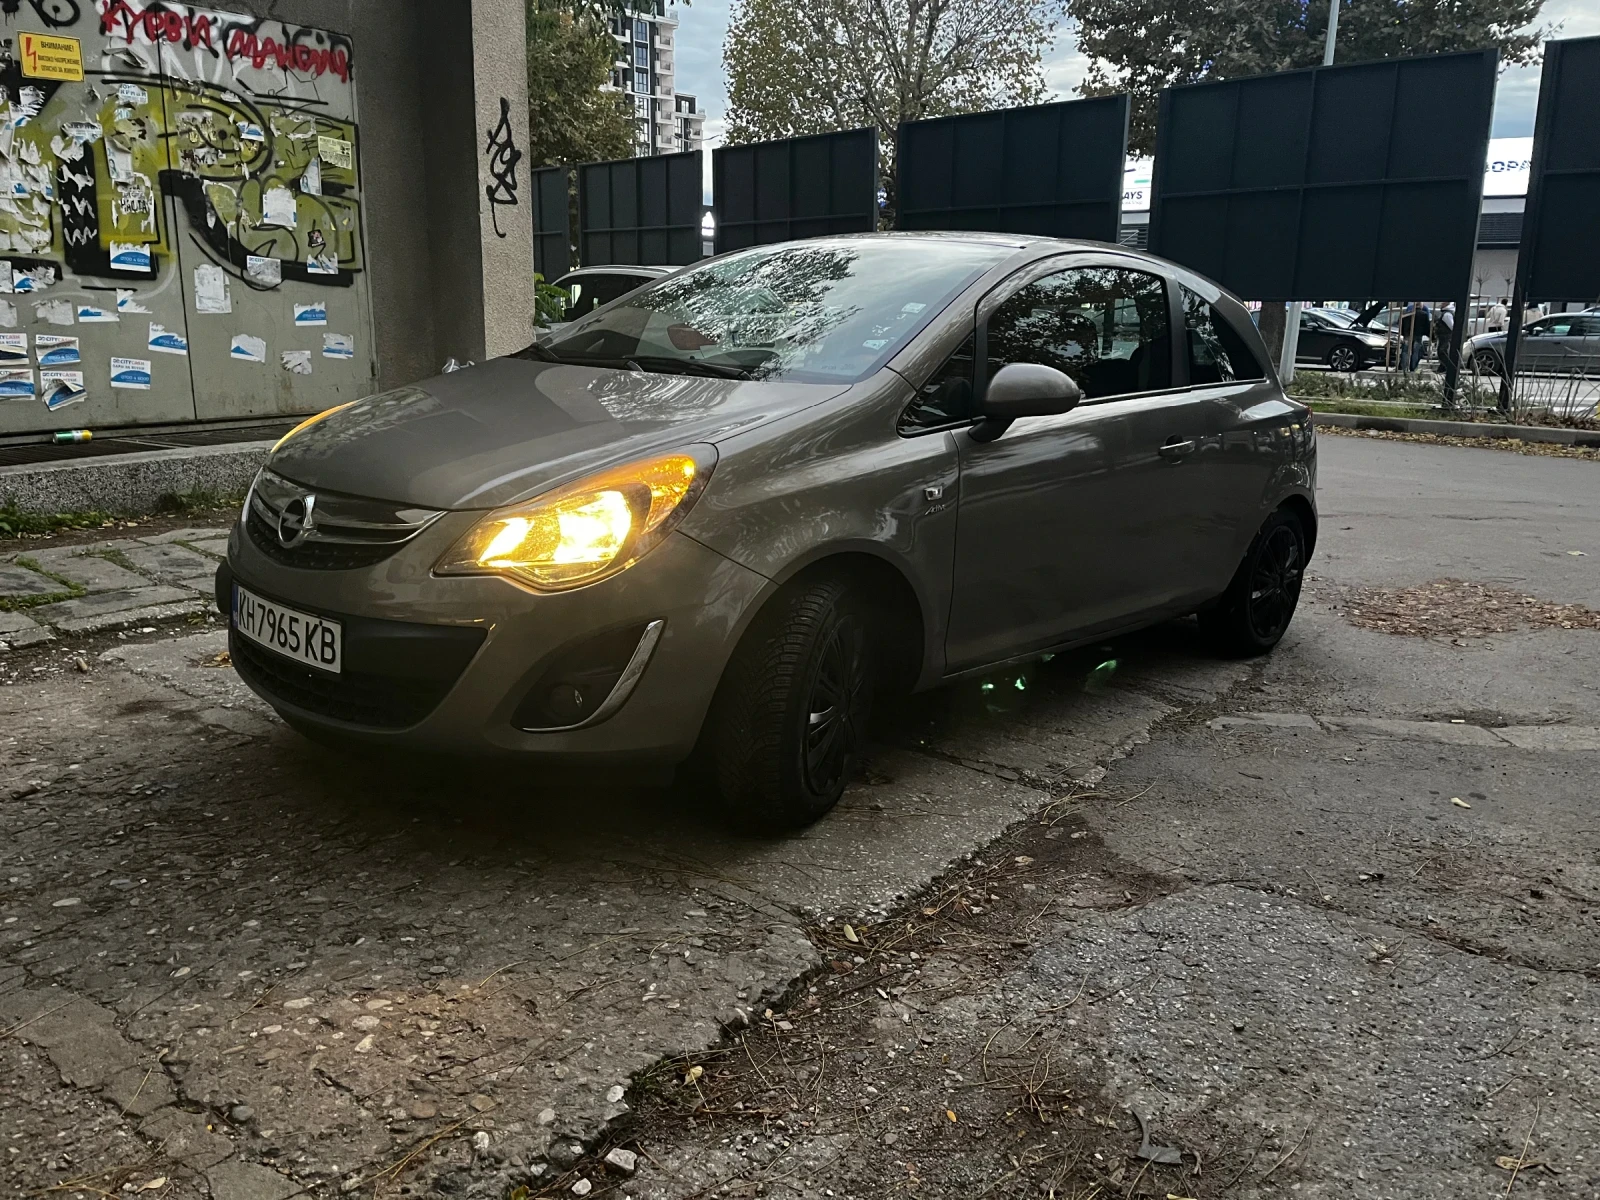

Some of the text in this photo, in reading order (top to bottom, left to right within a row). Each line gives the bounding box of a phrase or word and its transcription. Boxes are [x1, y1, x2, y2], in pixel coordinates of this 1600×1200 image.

[41, 41, 74, 52] ВНИМАНИЕ!
[1485, 160, 1531, 173] OPA
[1122, 191, 1143, 199] AYS
